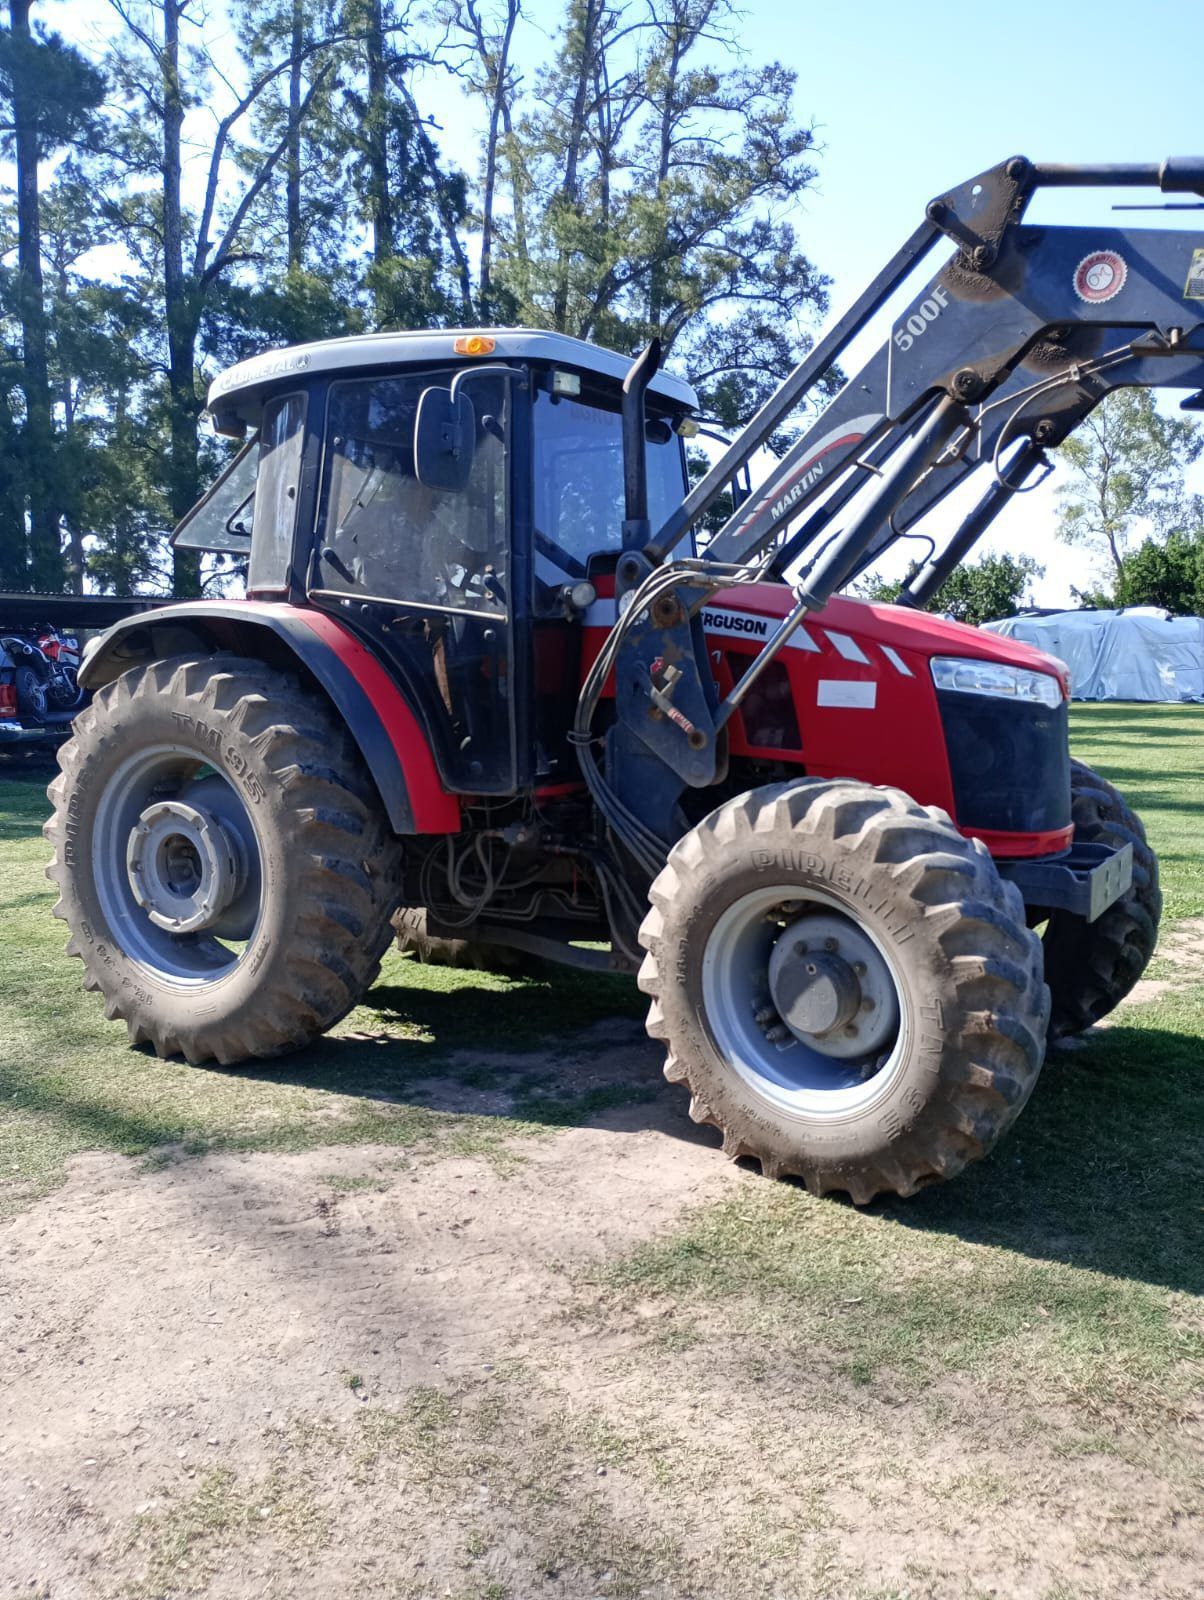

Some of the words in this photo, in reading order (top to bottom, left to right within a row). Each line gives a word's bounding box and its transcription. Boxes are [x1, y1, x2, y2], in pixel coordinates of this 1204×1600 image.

[894, 284, 948, 351] 500F
[770, 461, 824, 520] MARTIN
[701, 611, 768, 635] RGUSON
[751, 848, 915, 946] PIRELLI
